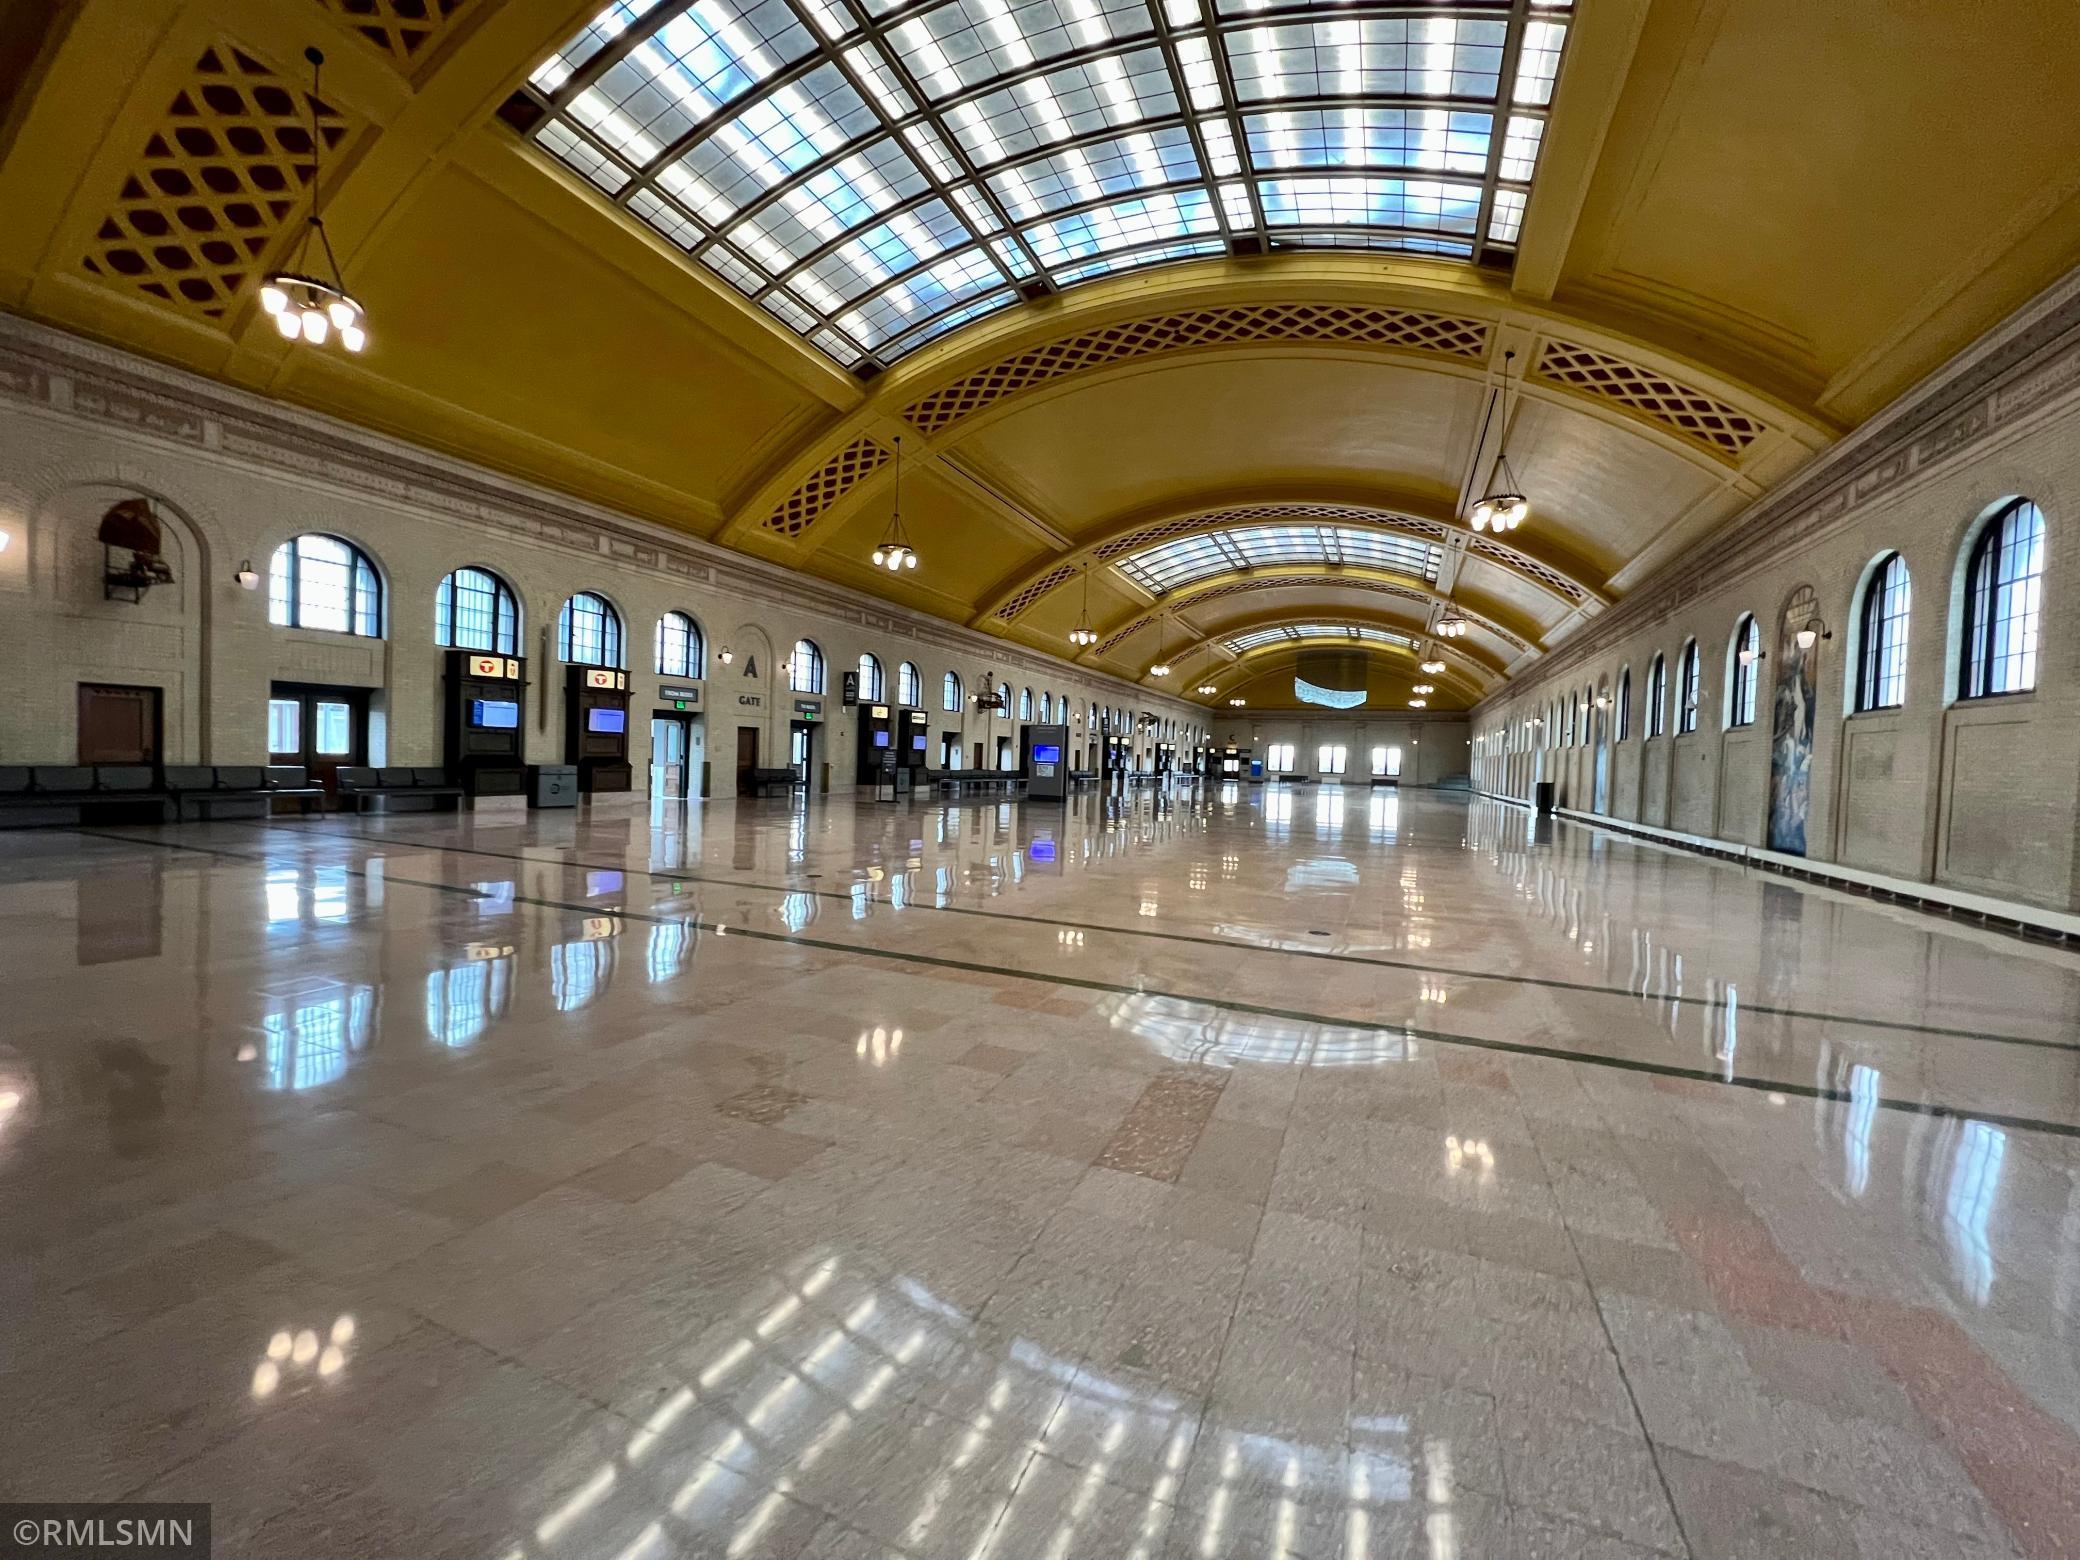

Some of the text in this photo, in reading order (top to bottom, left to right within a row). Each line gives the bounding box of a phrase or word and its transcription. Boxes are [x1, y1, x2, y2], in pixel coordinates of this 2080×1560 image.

[743, 654, 758, 678] A
[846, 674, 855, 685] A
[738, 695, 761, 707] GATE
